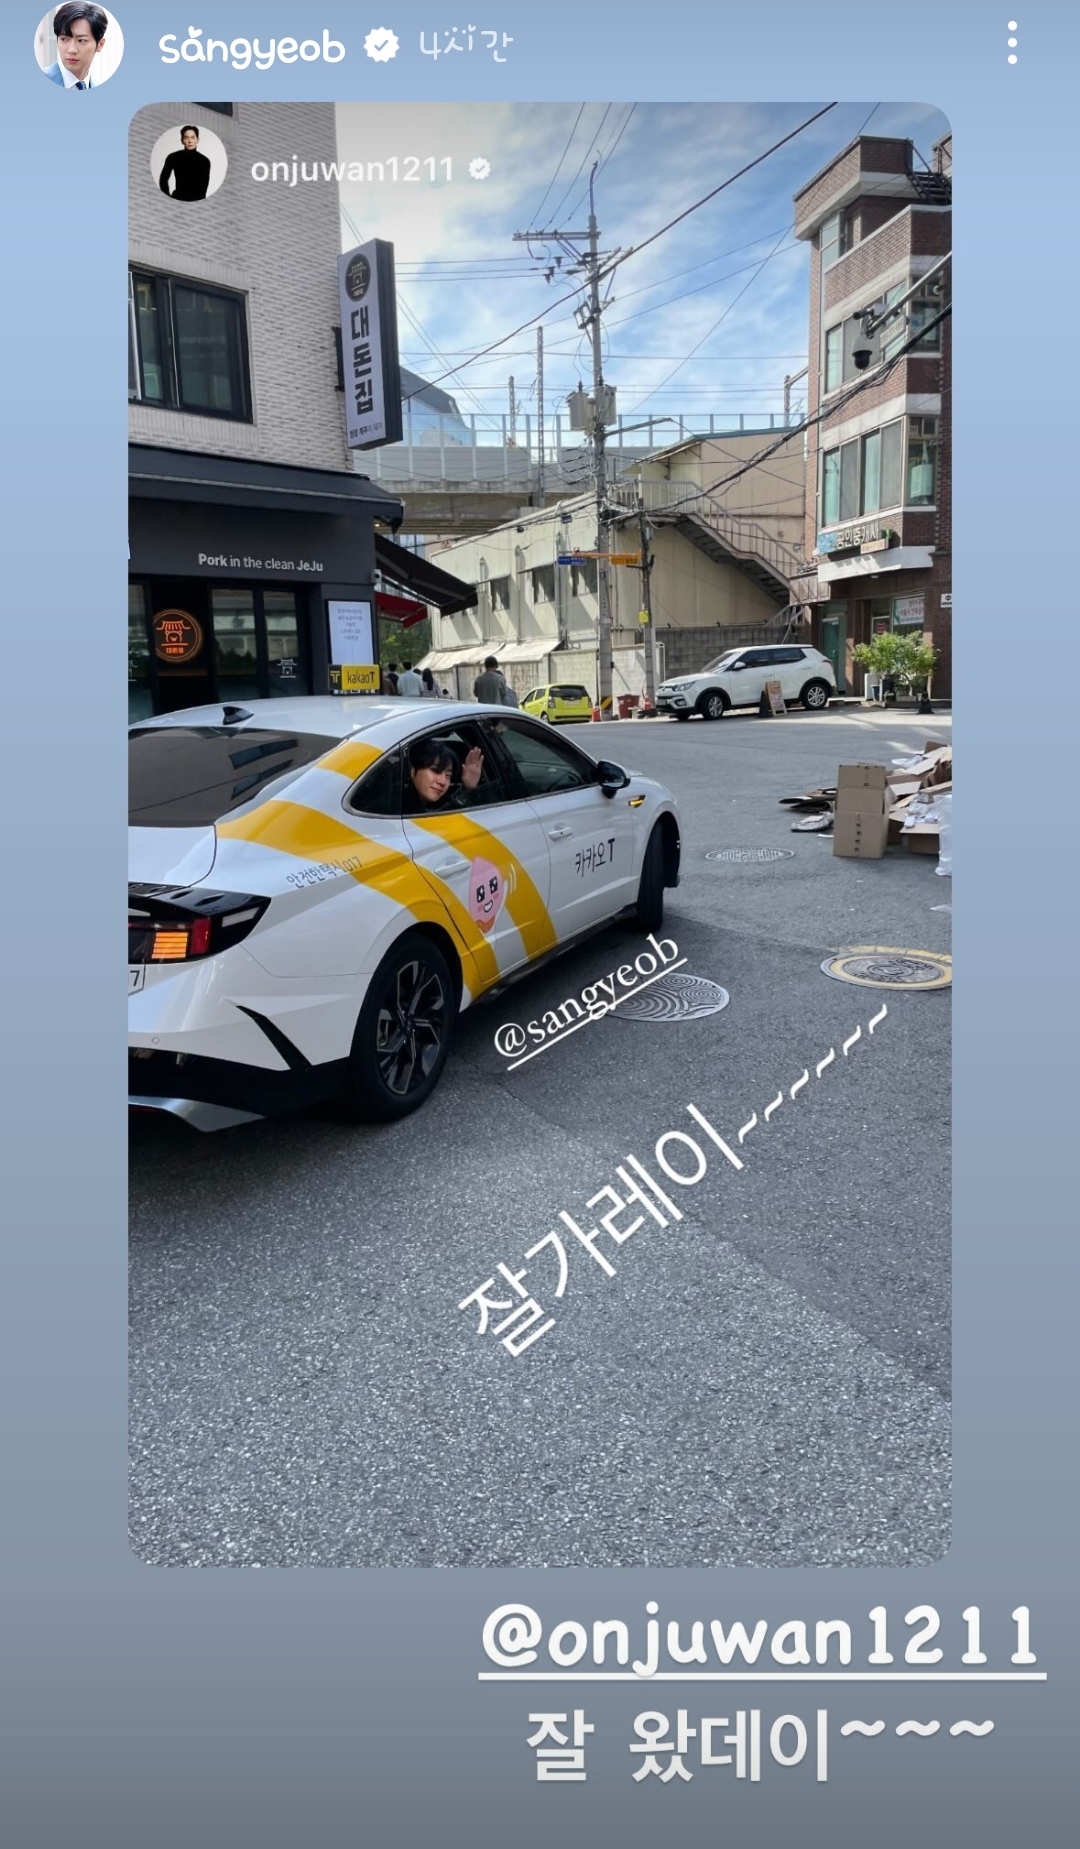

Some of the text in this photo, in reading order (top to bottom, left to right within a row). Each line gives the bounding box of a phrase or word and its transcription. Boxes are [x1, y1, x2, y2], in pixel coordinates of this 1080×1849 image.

[351, 305, 373, 415] 대돈집
[198, 553, 324, 572] Pork in the clean JeJu
